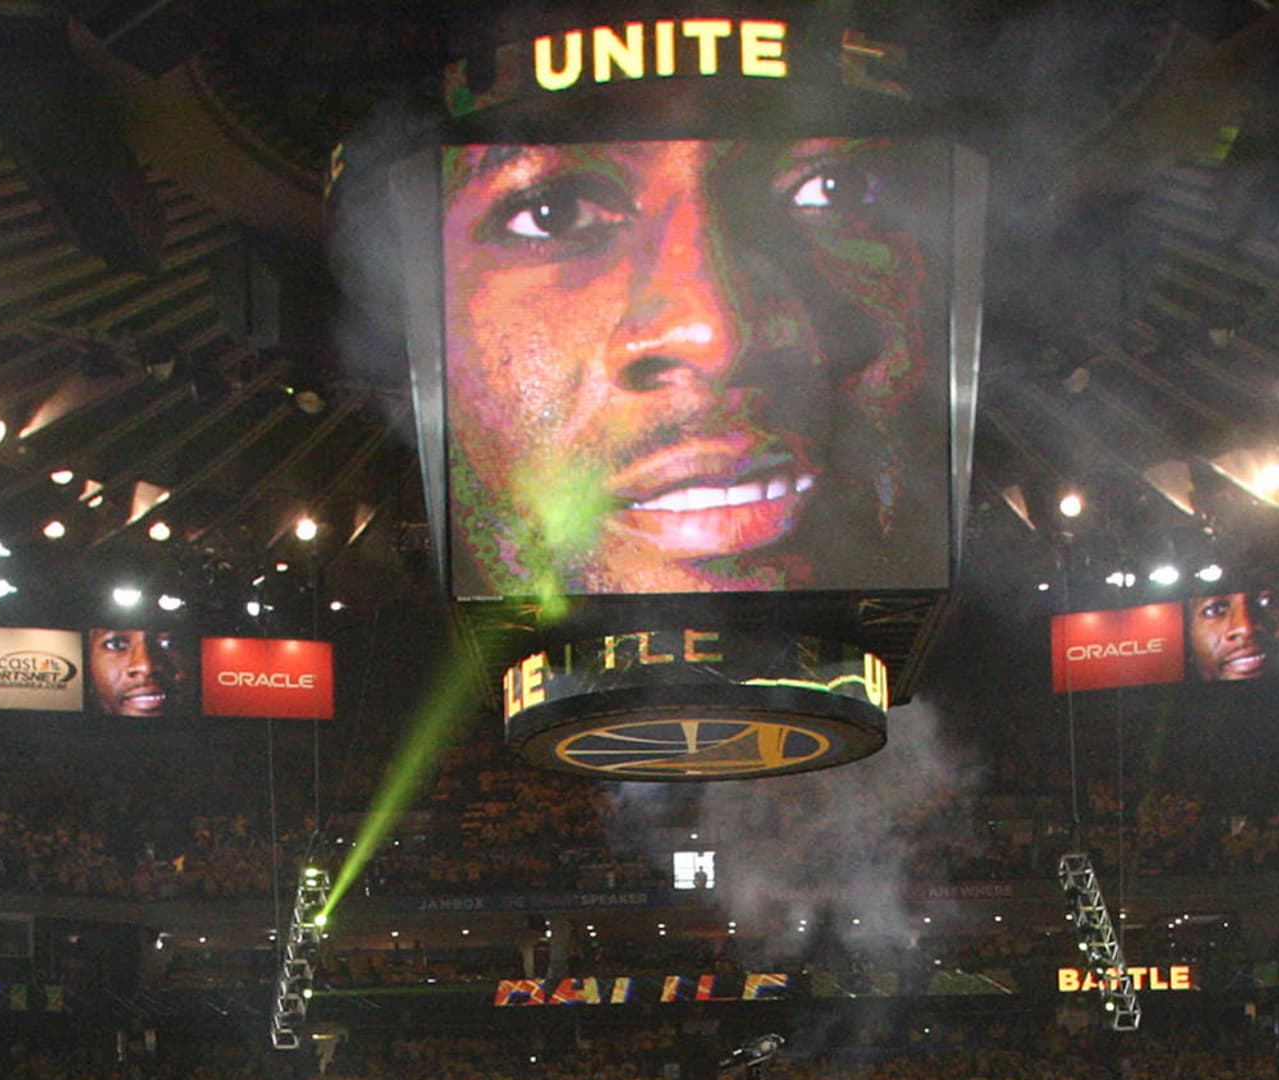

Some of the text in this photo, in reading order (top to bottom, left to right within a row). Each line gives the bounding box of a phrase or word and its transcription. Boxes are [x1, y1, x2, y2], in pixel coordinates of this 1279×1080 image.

[534, 20, 788, 91] UNITE
[1066, 639, 1164, 662] ORACLE
[218, 671, 316, 690] ORACLE
[1058, 965, 1191, 992] BATTLE
